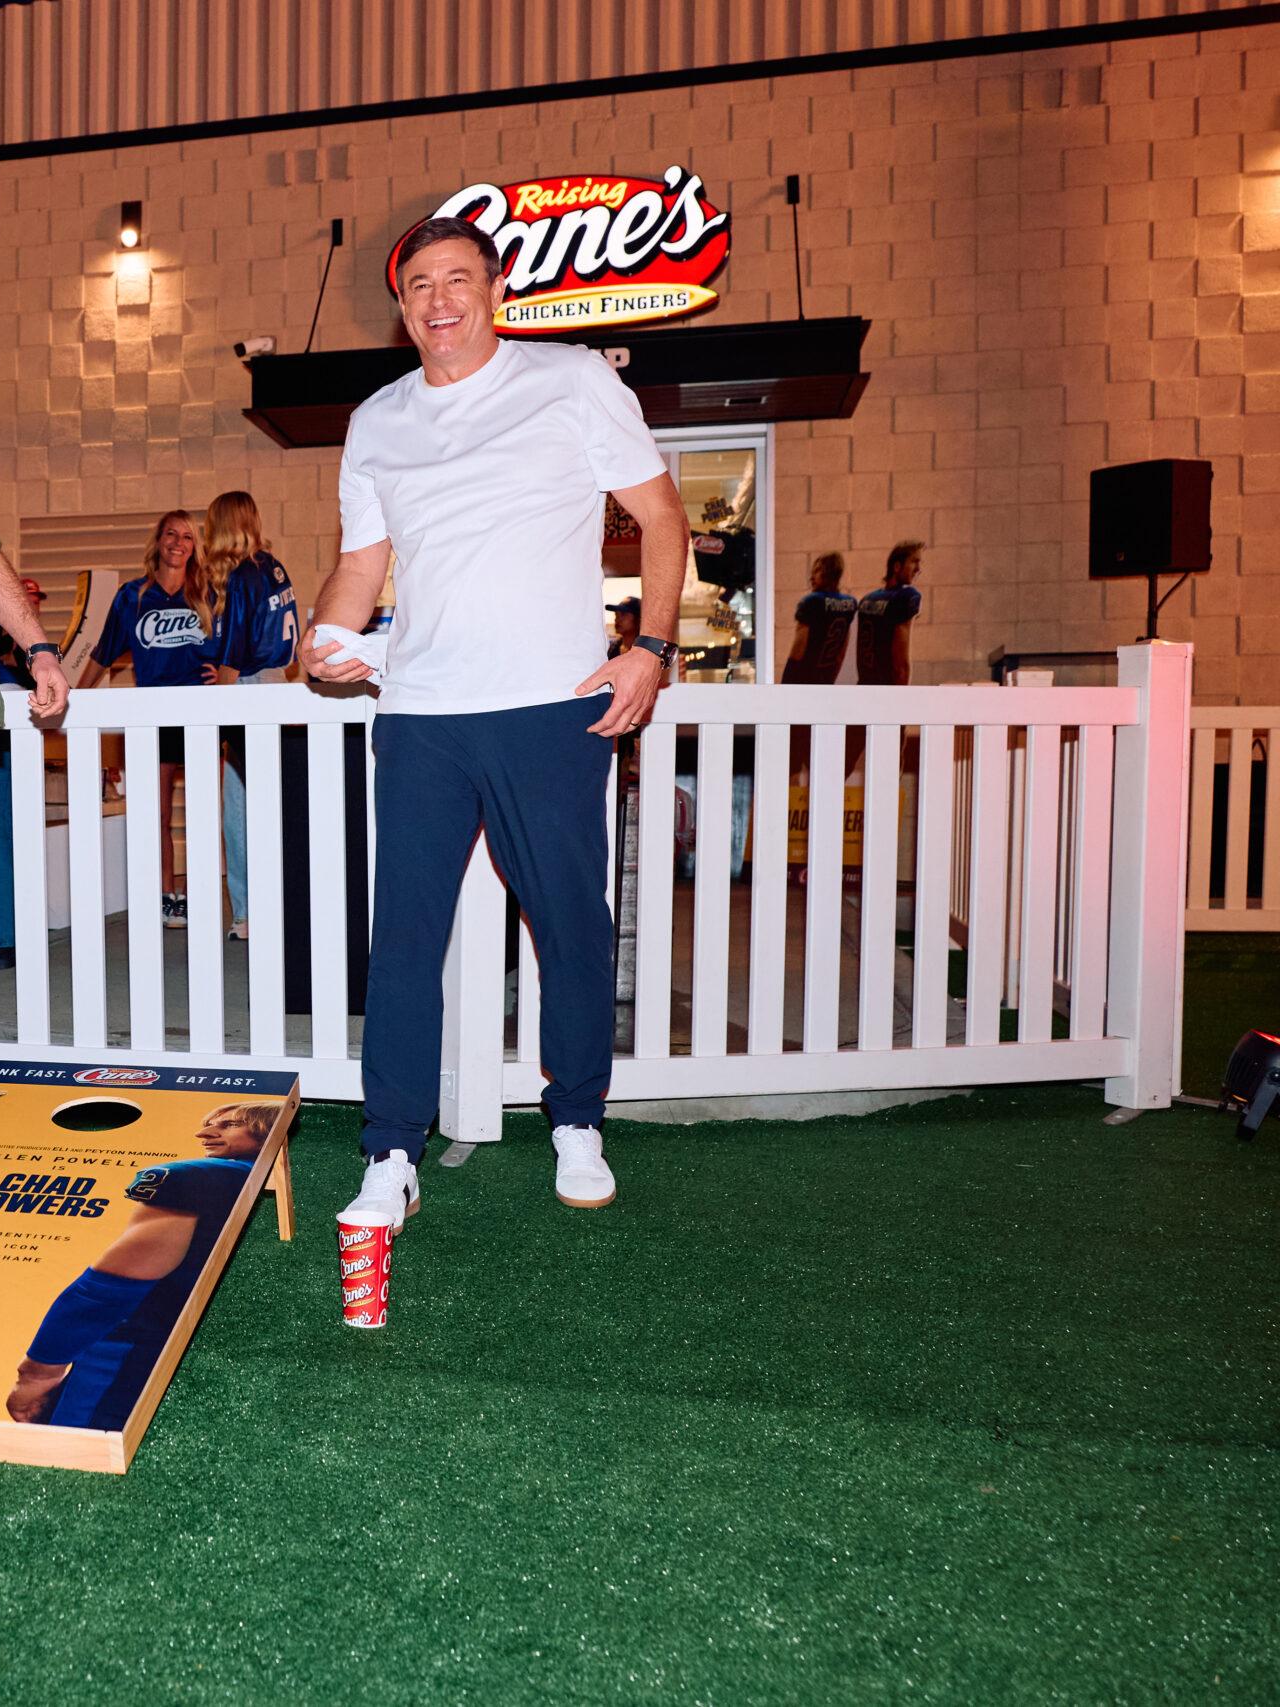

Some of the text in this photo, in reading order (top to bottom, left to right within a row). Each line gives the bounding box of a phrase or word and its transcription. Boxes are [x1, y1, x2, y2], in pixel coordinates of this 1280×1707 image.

[514, 177, 628, 217] Raising
[505, 291, 688, 323] CHICKEN FINGERS
[715, 608, 738, 620] CHAD
[24, 1069, 67, 1078] FAST.
[74, 1067, 160, 1083] Cane's
[176, 1075, 257, 1087] EAT FAST.
[53, 1156, 139, 1168] POWELL
[127, 1150, 178, 1158] MANNING
[124, 1167, 170, 1200] 2
[4, 1243, 39, 1251] ICON
[338, 1227, 375, 1252] Cane's
[340, 1255, 374, 1280] Cane's
[342, 1282, 374, 1307] Cane's
